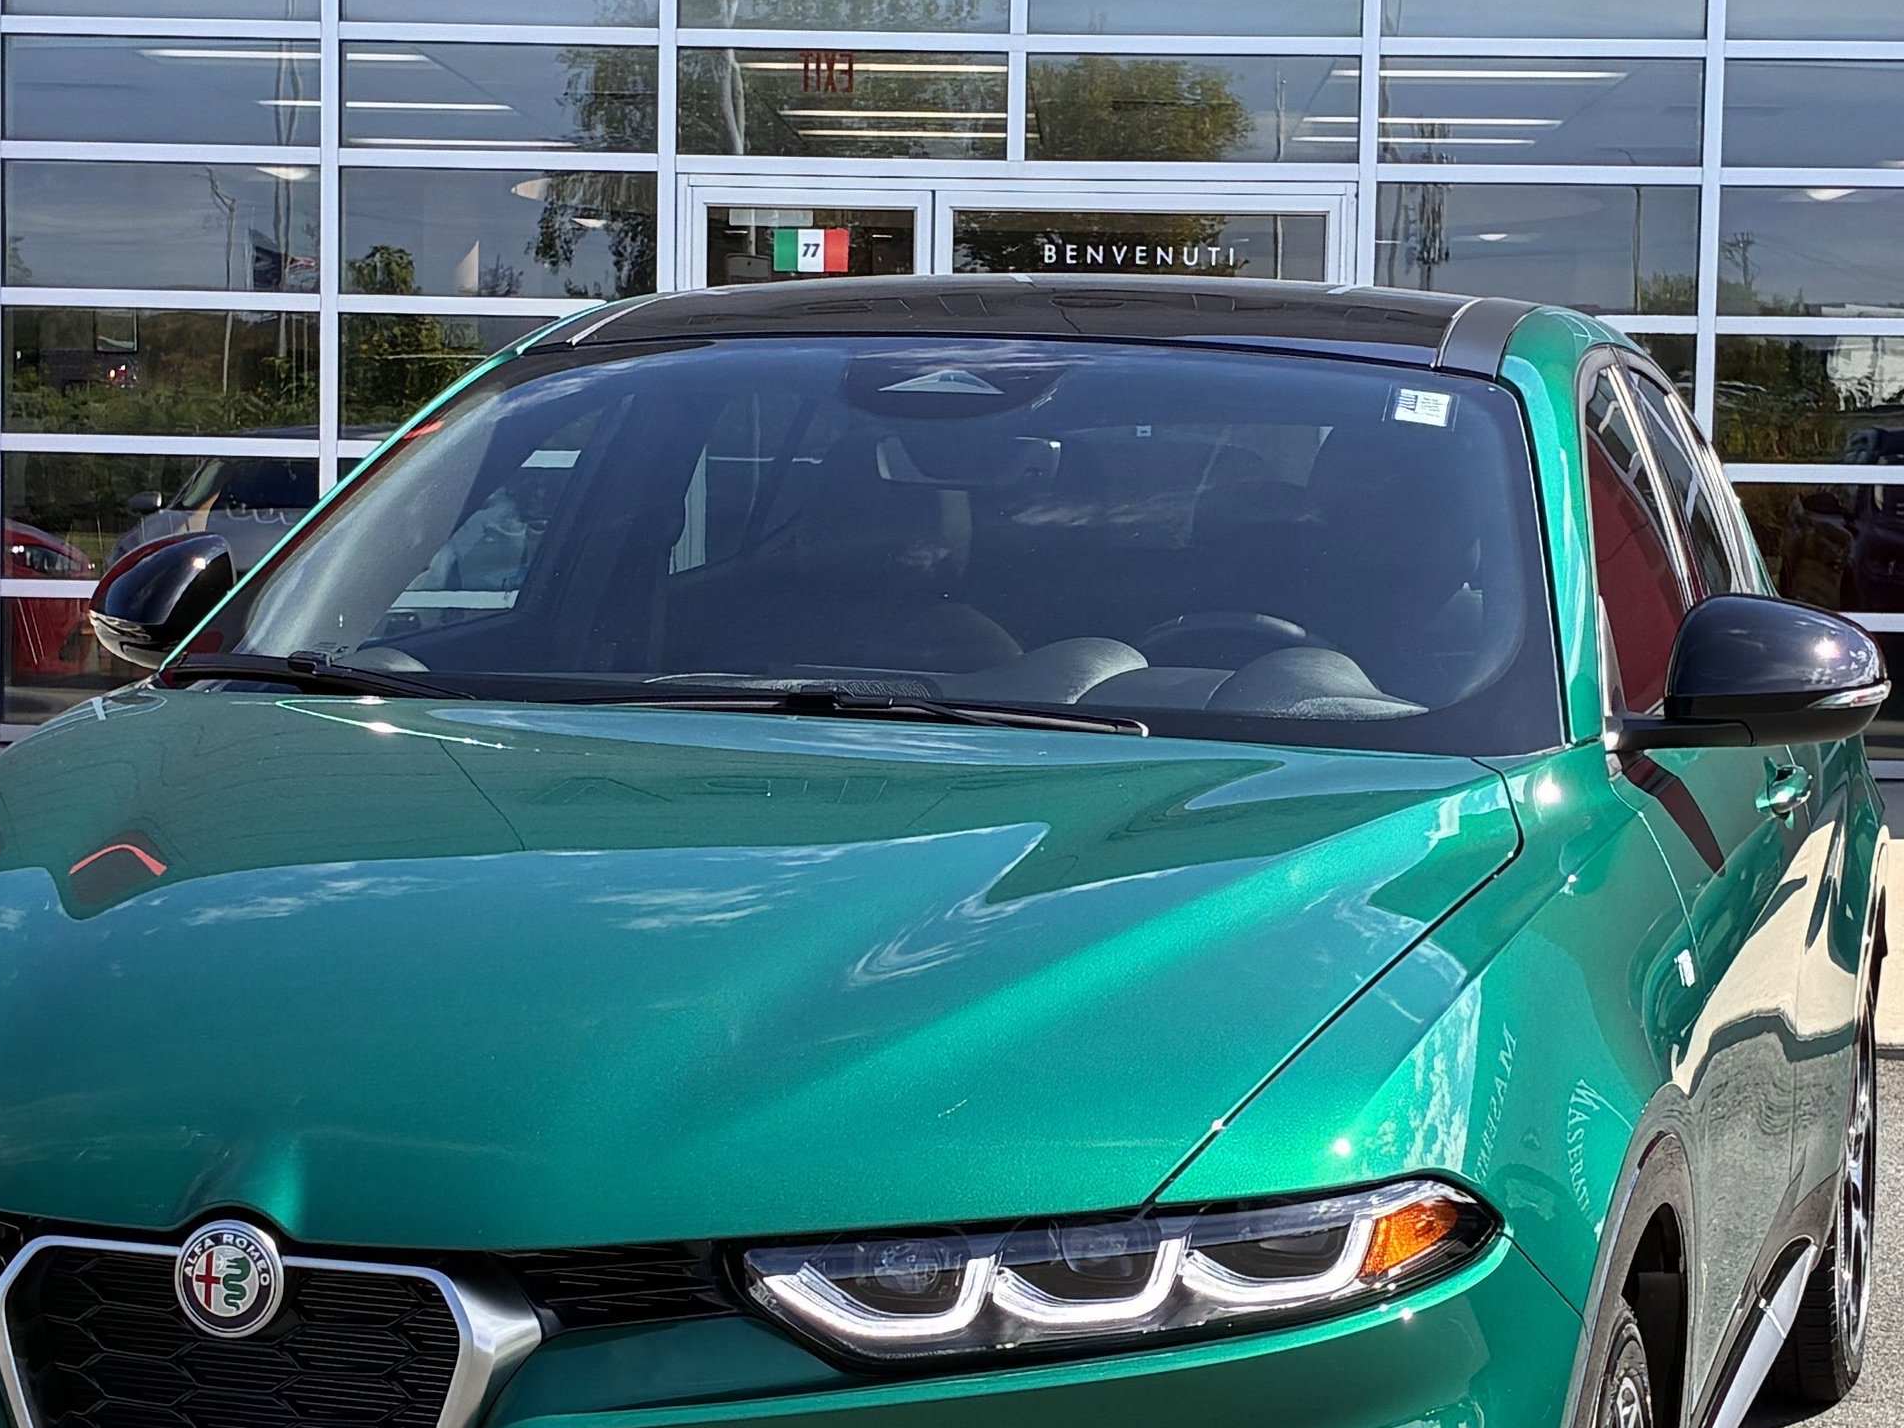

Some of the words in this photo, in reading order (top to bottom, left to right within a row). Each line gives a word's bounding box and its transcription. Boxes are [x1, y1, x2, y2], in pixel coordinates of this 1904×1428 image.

[1044, 243, 1234, 266] BENVENUTI
[184, 1238, 215, 1277] ALFA
[223, 1233, 271, 1286] ROMEO
